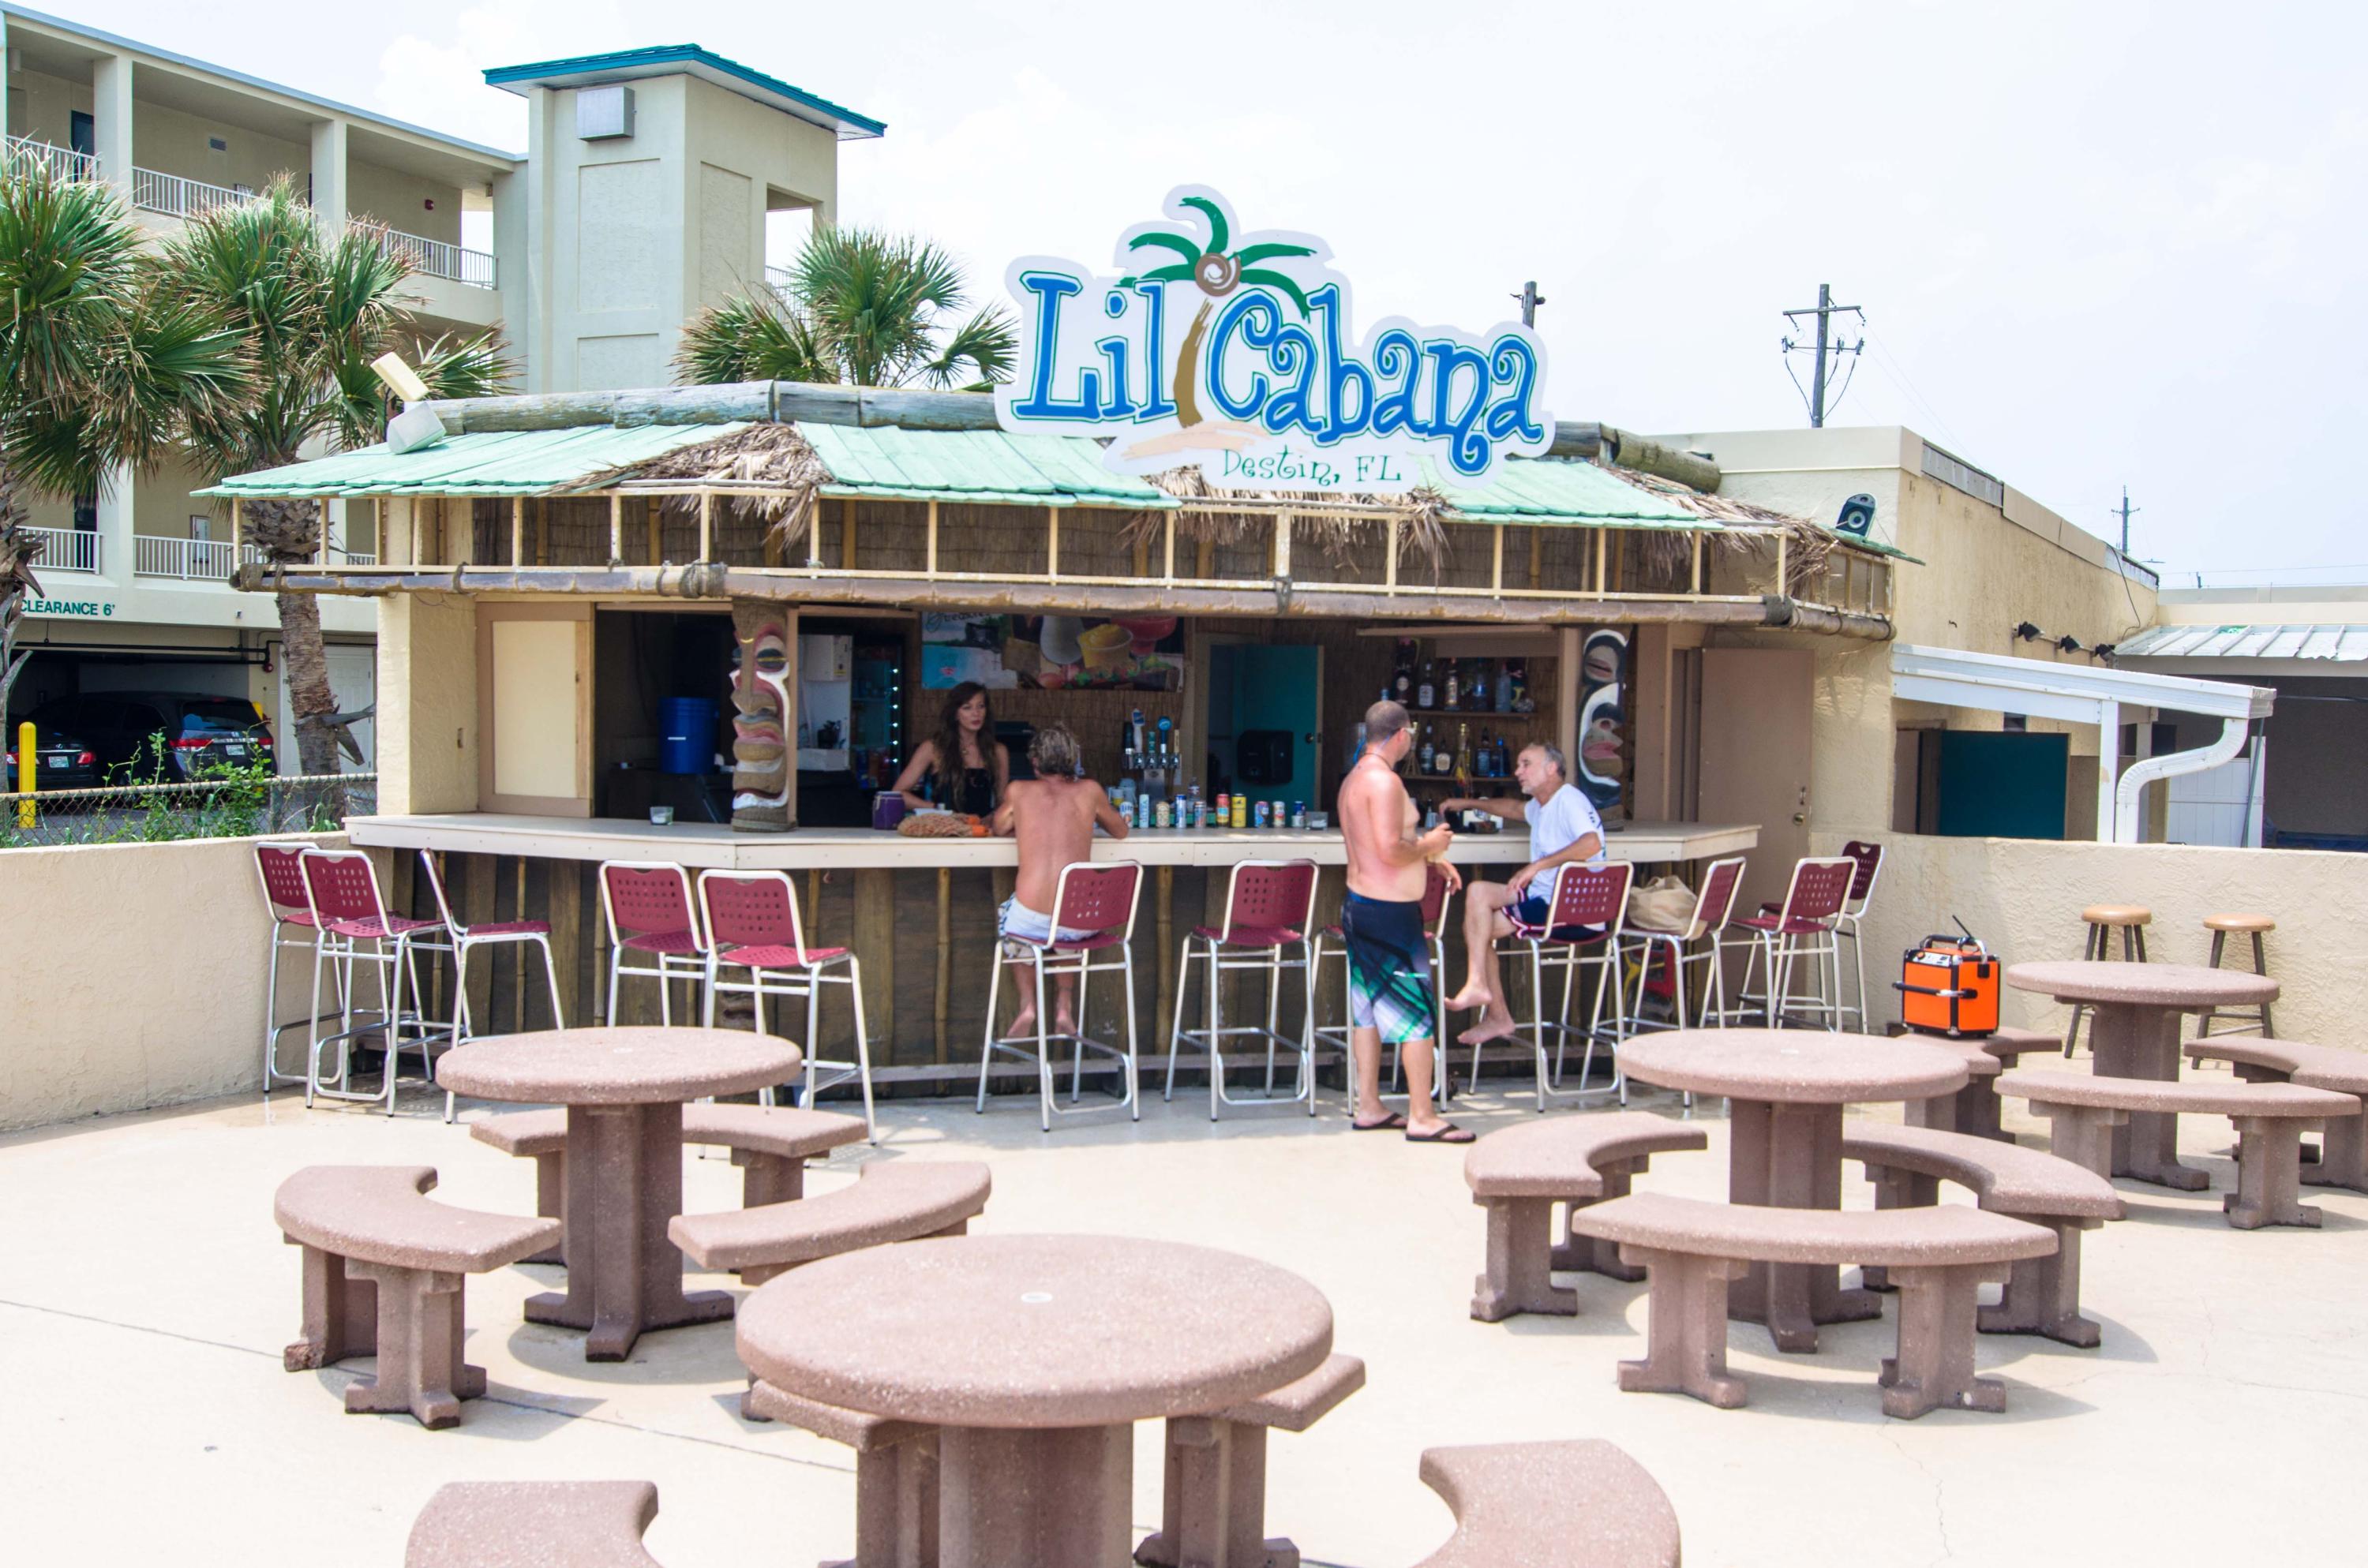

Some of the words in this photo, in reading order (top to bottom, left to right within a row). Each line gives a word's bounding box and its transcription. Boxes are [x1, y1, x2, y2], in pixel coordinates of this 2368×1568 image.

[1011, 271, 1180, 425] Lil
[1206, 283, 1543, 475] Cabana
[1223, 444, 1340, 487] Destin,
[1354, 455, 1402, 482] FL
[21, 599, 98, 616] CLEARANCE
[103, 603, 115, 616] 6'
